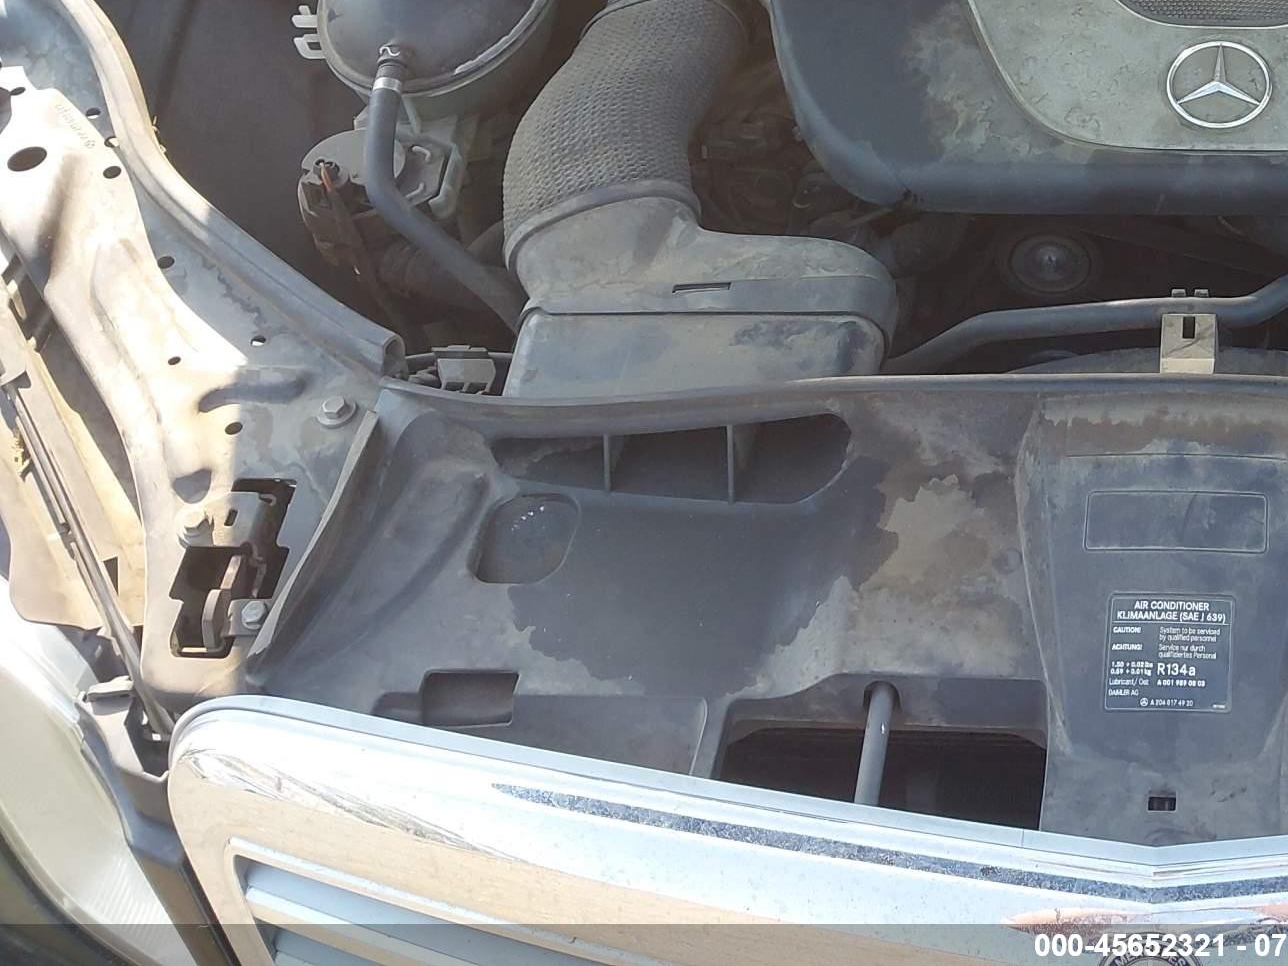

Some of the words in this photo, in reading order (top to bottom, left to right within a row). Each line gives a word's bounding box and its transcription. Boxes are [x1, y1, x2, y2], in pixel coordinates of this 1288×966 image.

[1134, 601, 1149, 610] AIR
[1150, 601, 1210, 611] CONDITIONER
[1117, 610, 1178, 620] KLIMAANLAGE
[1179, 612, 1199, 622] (SAE
[1206, 613, 1226, 623] 639)
[1113, 626, 1142, 634] CAUTION!
[1160, 626, 1181, 635] System
[1197, 627, 1221, 636] serviced
[1159, 634, 1166, 642] by
[1167, 634, 1190, 642] qualified
[1191, 635, 1217, 643] personnel
[1112, 643, 1142, 651] ACHTUNG!
[1190, 645, 1206, 653] durch
[1193, 652, 1217, 660] Personal
[1157, 662, 1196, 676] R134a
